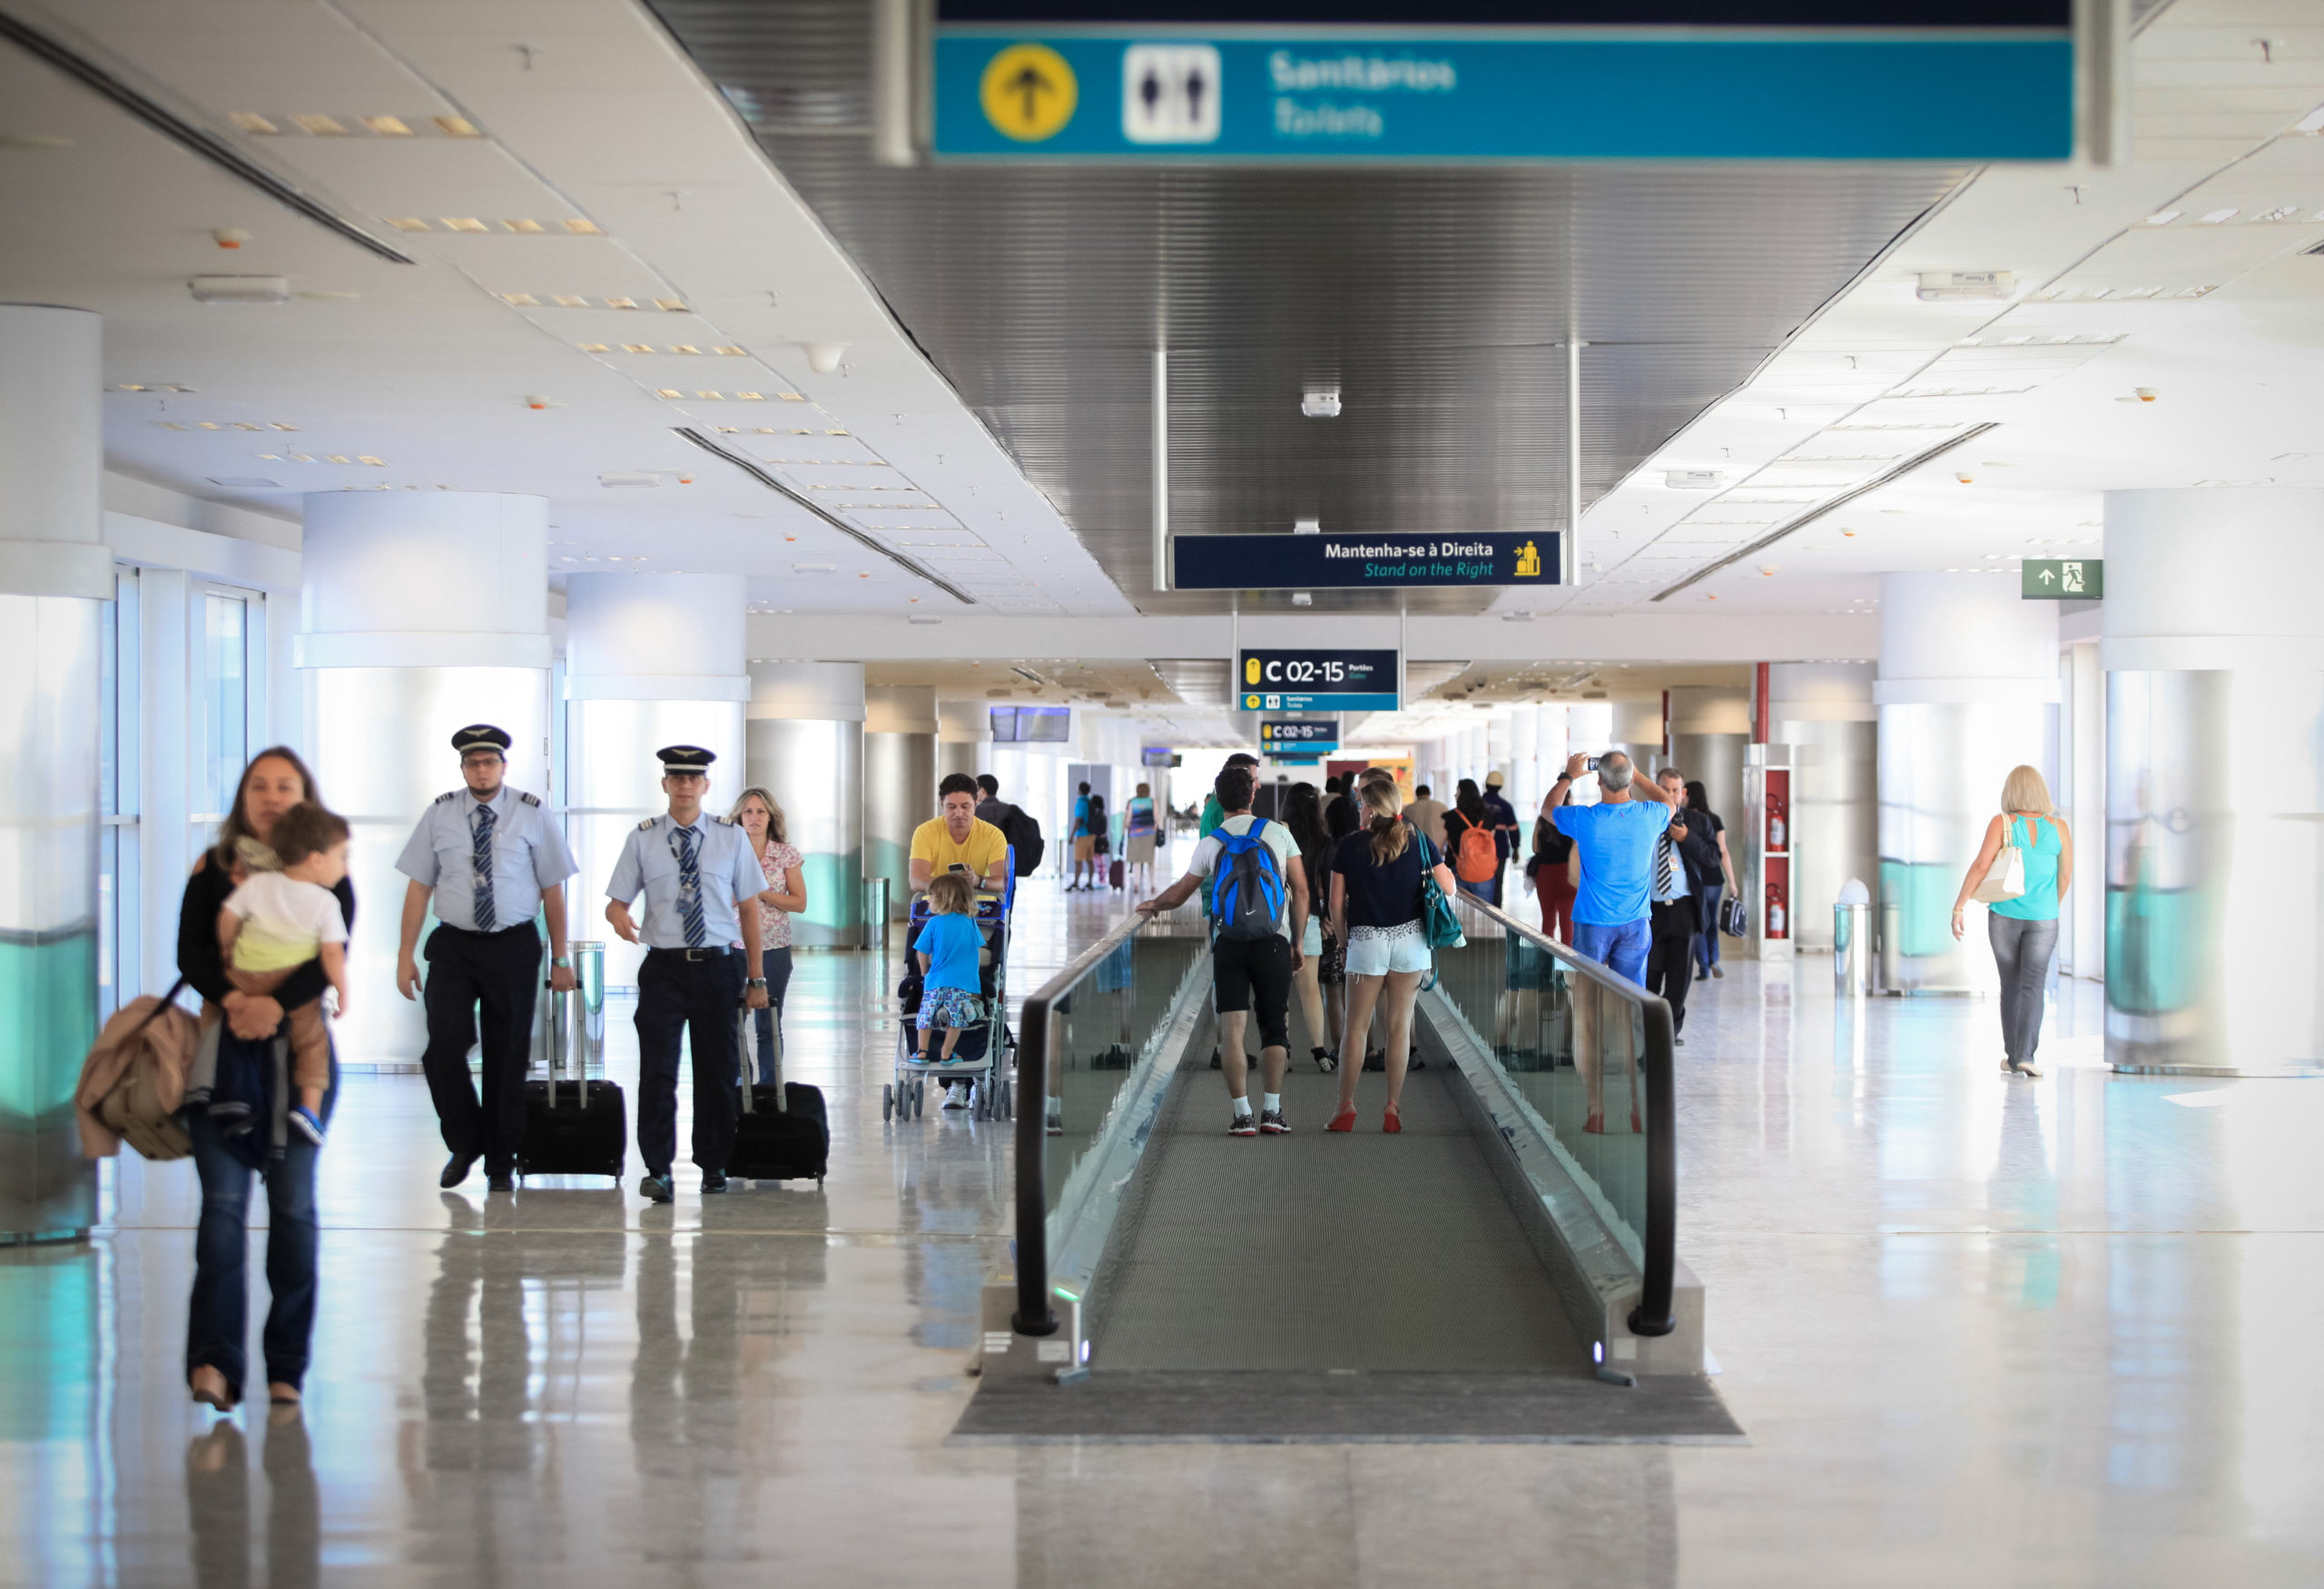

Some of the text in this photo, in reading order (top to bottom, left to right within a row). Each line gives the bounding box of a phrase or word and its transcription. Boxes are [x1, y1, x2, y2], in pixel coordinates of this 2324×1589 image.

[1269, 51, 1456, 92] Sanitários
[1325, 542, 1493, 558] Mantenha-se à Direita
[1364, 561, 1494, 579] Stand on the Right
[1265, 660, 1344, 682] C 02-15
[1273, 725, 1282, 738] C
[1283, 725, 1314, 738] 02-15
